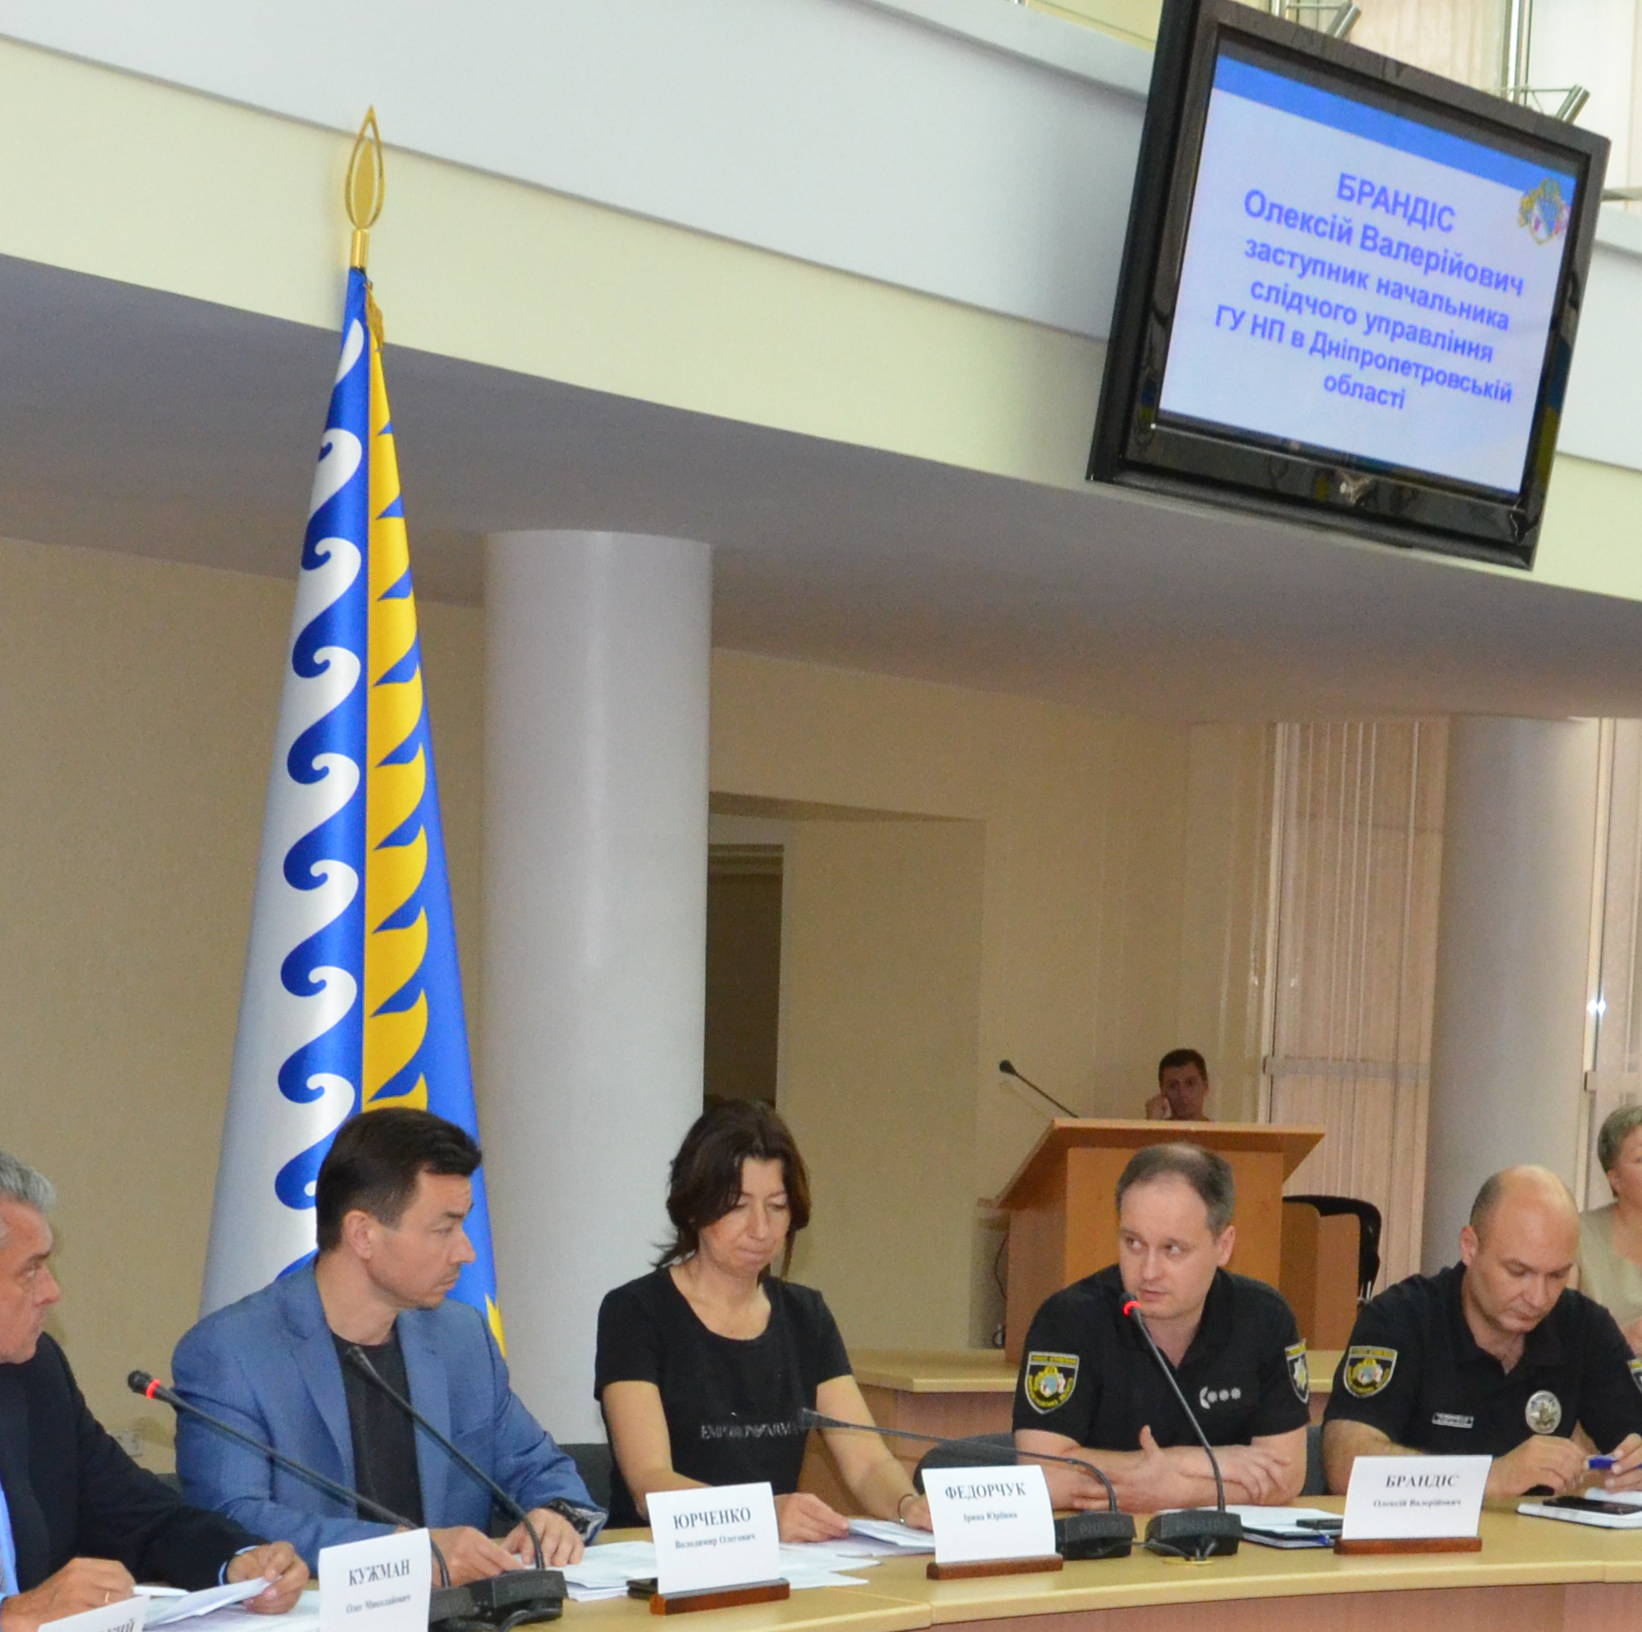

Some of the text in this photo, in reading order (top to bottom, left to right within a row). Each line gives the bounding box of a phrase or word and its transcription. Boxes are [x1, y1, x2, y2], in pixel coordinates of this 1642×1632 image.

[1337, 172, 1455, 232] БРАНДІС
[1244, 189, 1524, 297] Олексій Валерійович
[1244, 238, 1509, 331] заступник начальника
[1250, 281, 1493, 362] слідчого управління
[1215, 304, 1513, 403] ГУ НП в Дніпропетровській
[1323, 373, 1405, 410] області
[944, 1482, 1026, 1501] ФЕДОРЧУК
[1385, 1474, 1460, 1489] БРАНДІС
[672, 1507, 752, 1530] ЮРЧЕНКО
[348, 1559, 410, 1587] КУЖМАН
